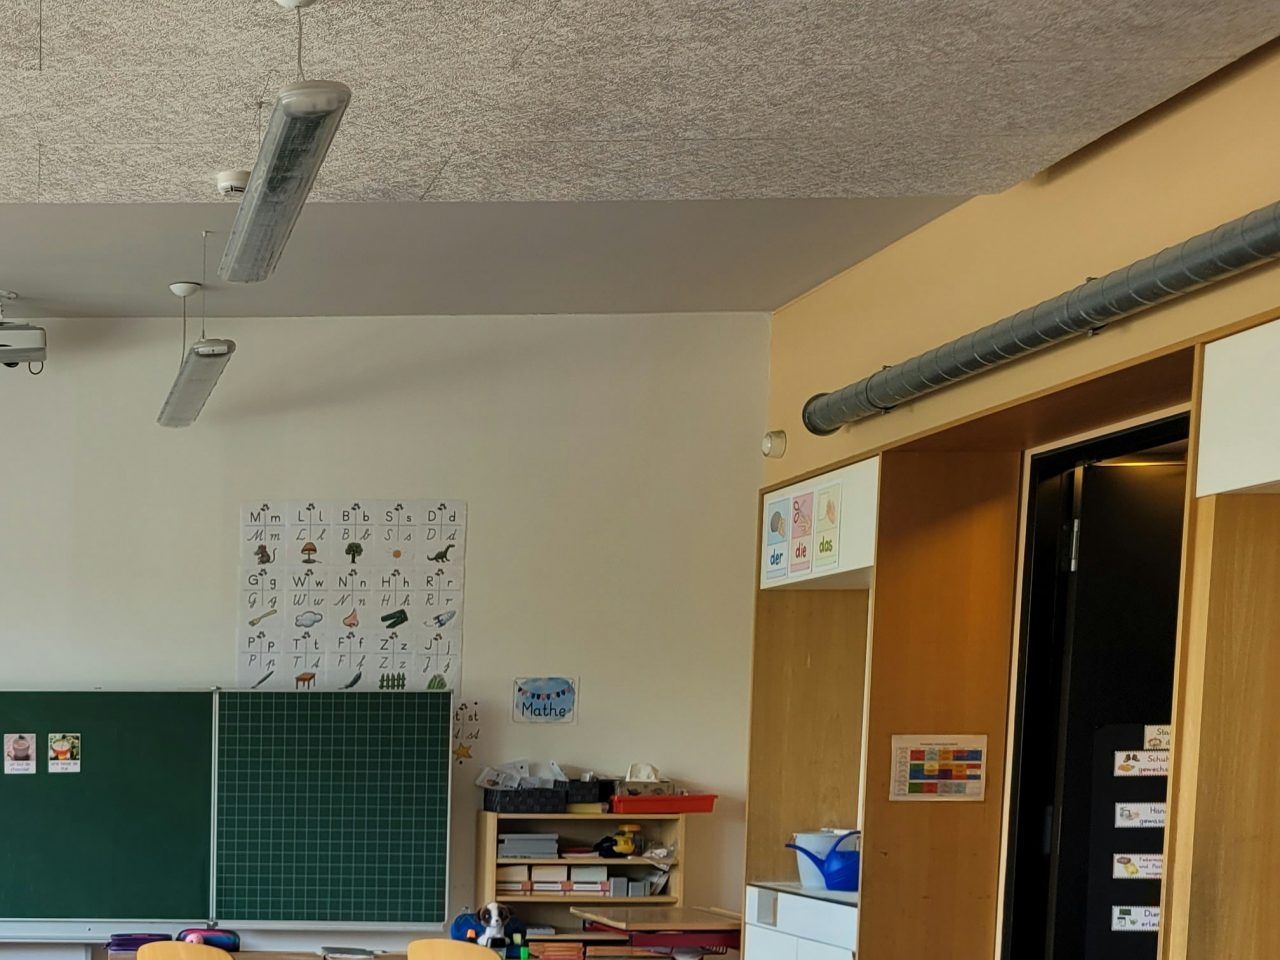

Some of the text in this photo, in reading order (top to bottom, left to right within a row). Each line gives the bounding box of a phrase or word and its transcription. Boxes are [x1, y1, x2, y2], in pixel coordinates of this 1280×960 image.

[796, 543, 806, 558] die
[819, 536, 832, 553] das
[770, 549, 783, 565] der
[521, 701, 566, 717] Mathe
